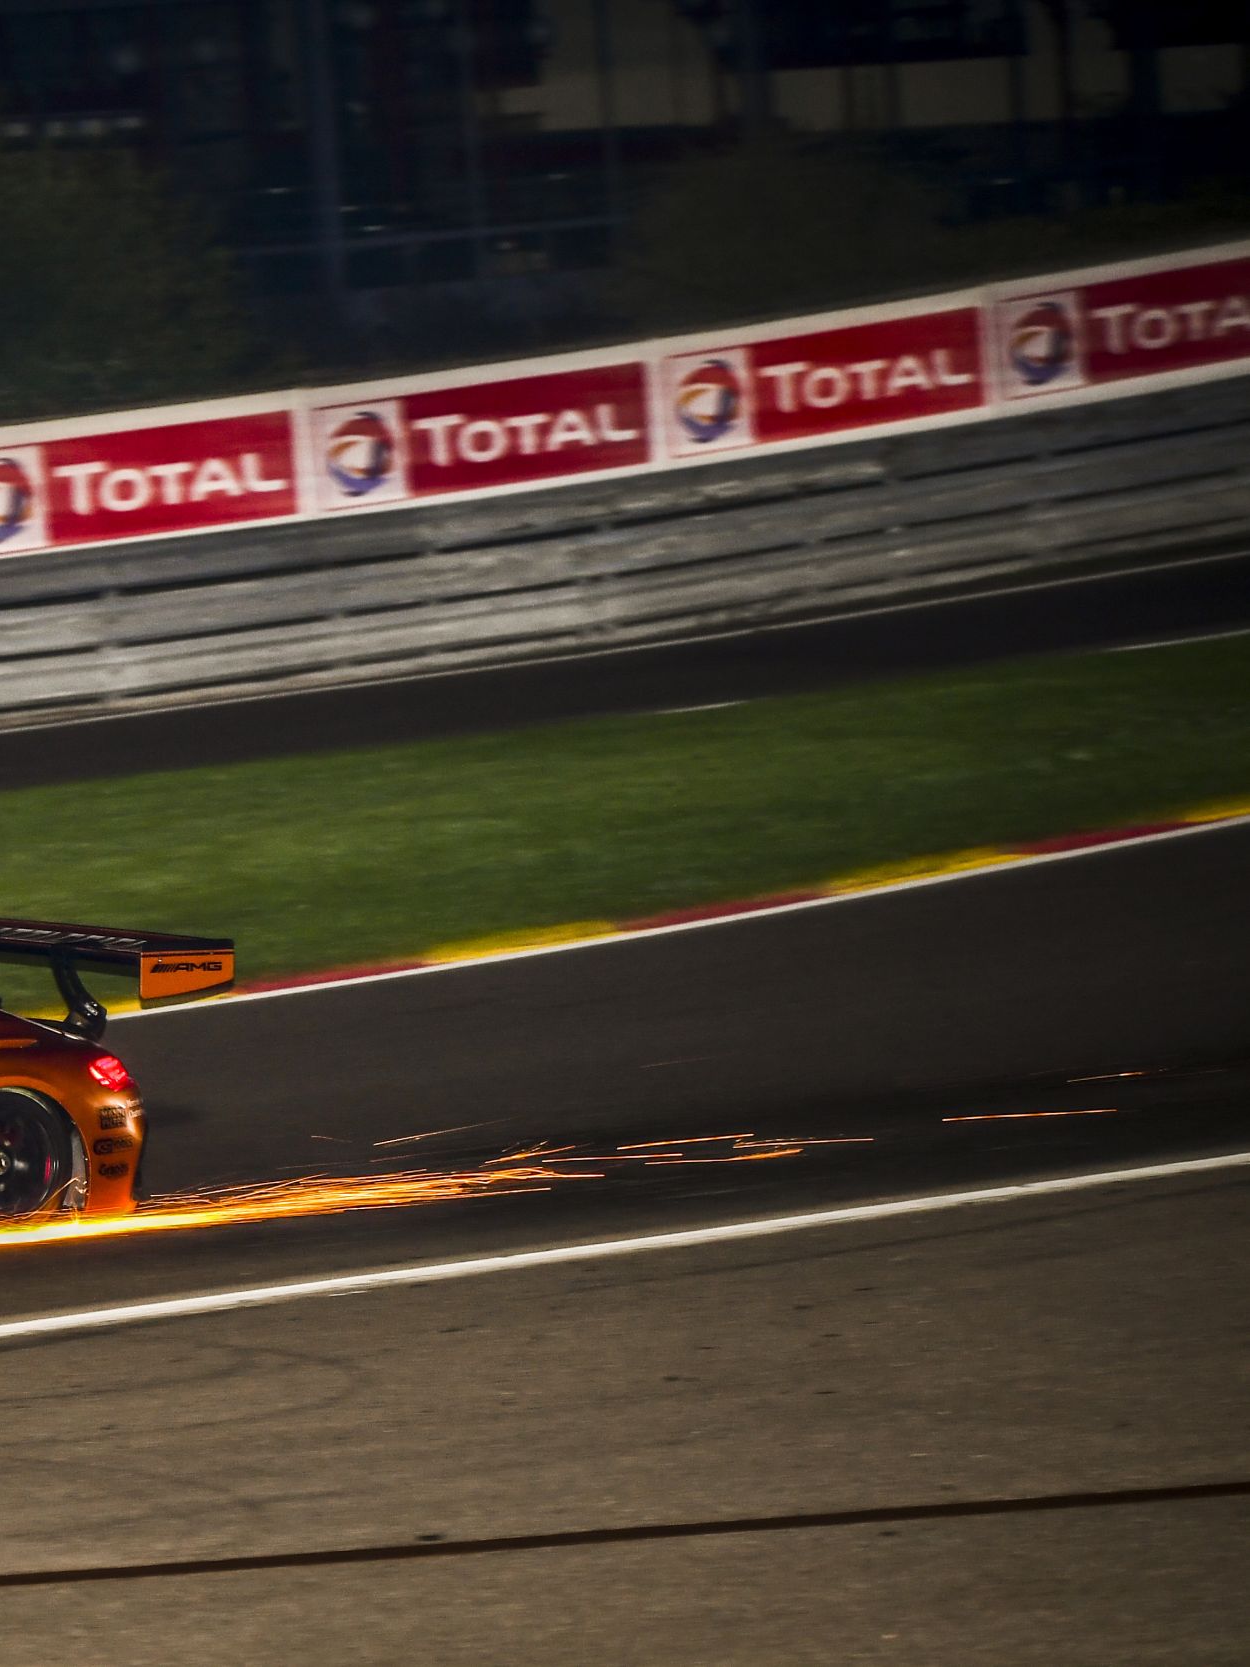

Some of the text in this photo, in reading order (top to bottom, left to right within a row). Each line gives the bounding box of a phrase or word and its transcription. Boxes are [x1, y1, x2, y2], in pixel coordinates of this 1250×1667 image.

[1092, 295, 1250, 352] TOTA
[756, 348, 976, 412] TOTAL
[414, 404, 640, 468] TOTAL
[53, 453, 285, 513] TOTAL
[174, 962, 222, 973] AMG
